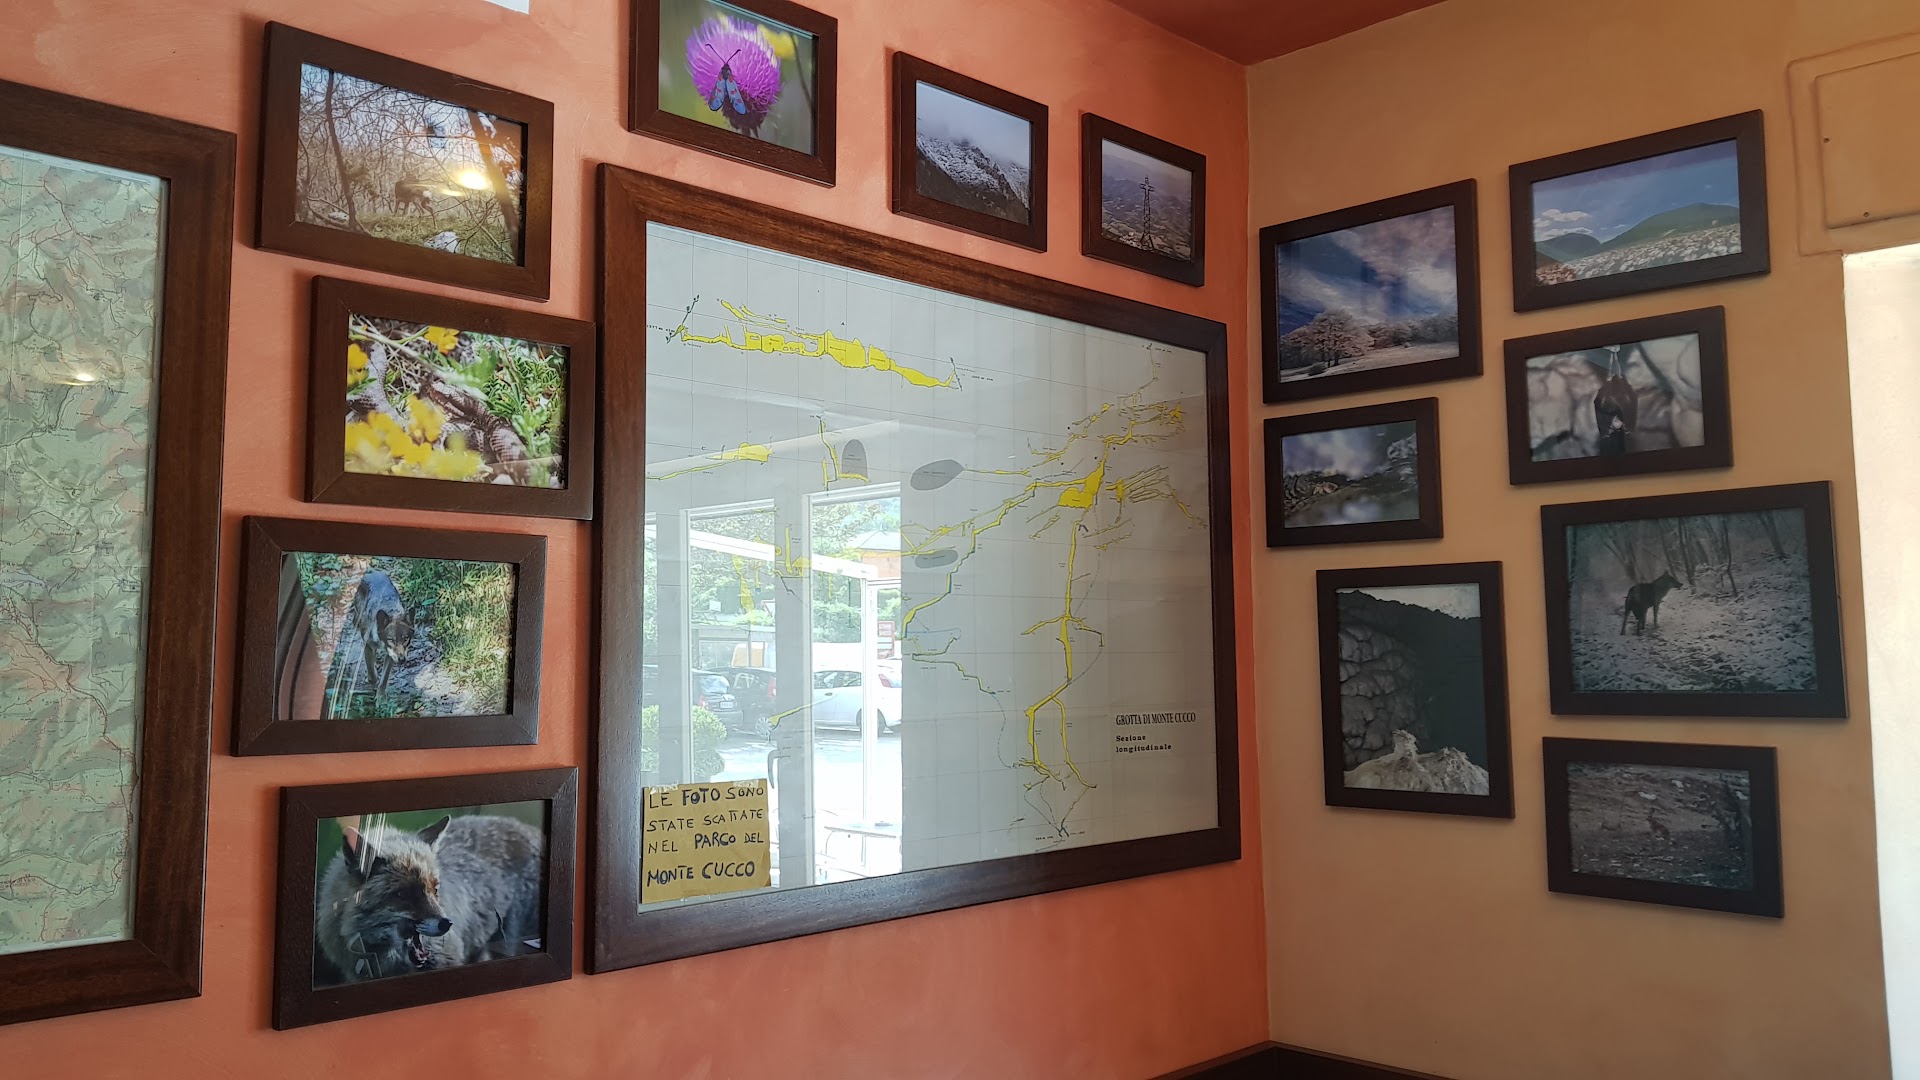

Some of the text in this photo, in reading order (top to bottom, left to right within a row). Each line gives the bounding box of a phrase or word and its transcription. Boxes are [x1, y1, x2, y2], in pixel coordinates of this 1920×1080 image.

[1115, 712, 1196, 726] GROTTA DI MONTE CUCCO
[1115, 734, 1146, 742] Sezione
[1115, 743, 1172, 754] longitudinale
[649, 786, 764, 809] LE FOTO SONO
[646, 809, 763, 832] STATE SCATTATE
[648, 831, 764, 854] NEL PARCO DEL
[646, 861, 755, 887] MONTE CUCCO
